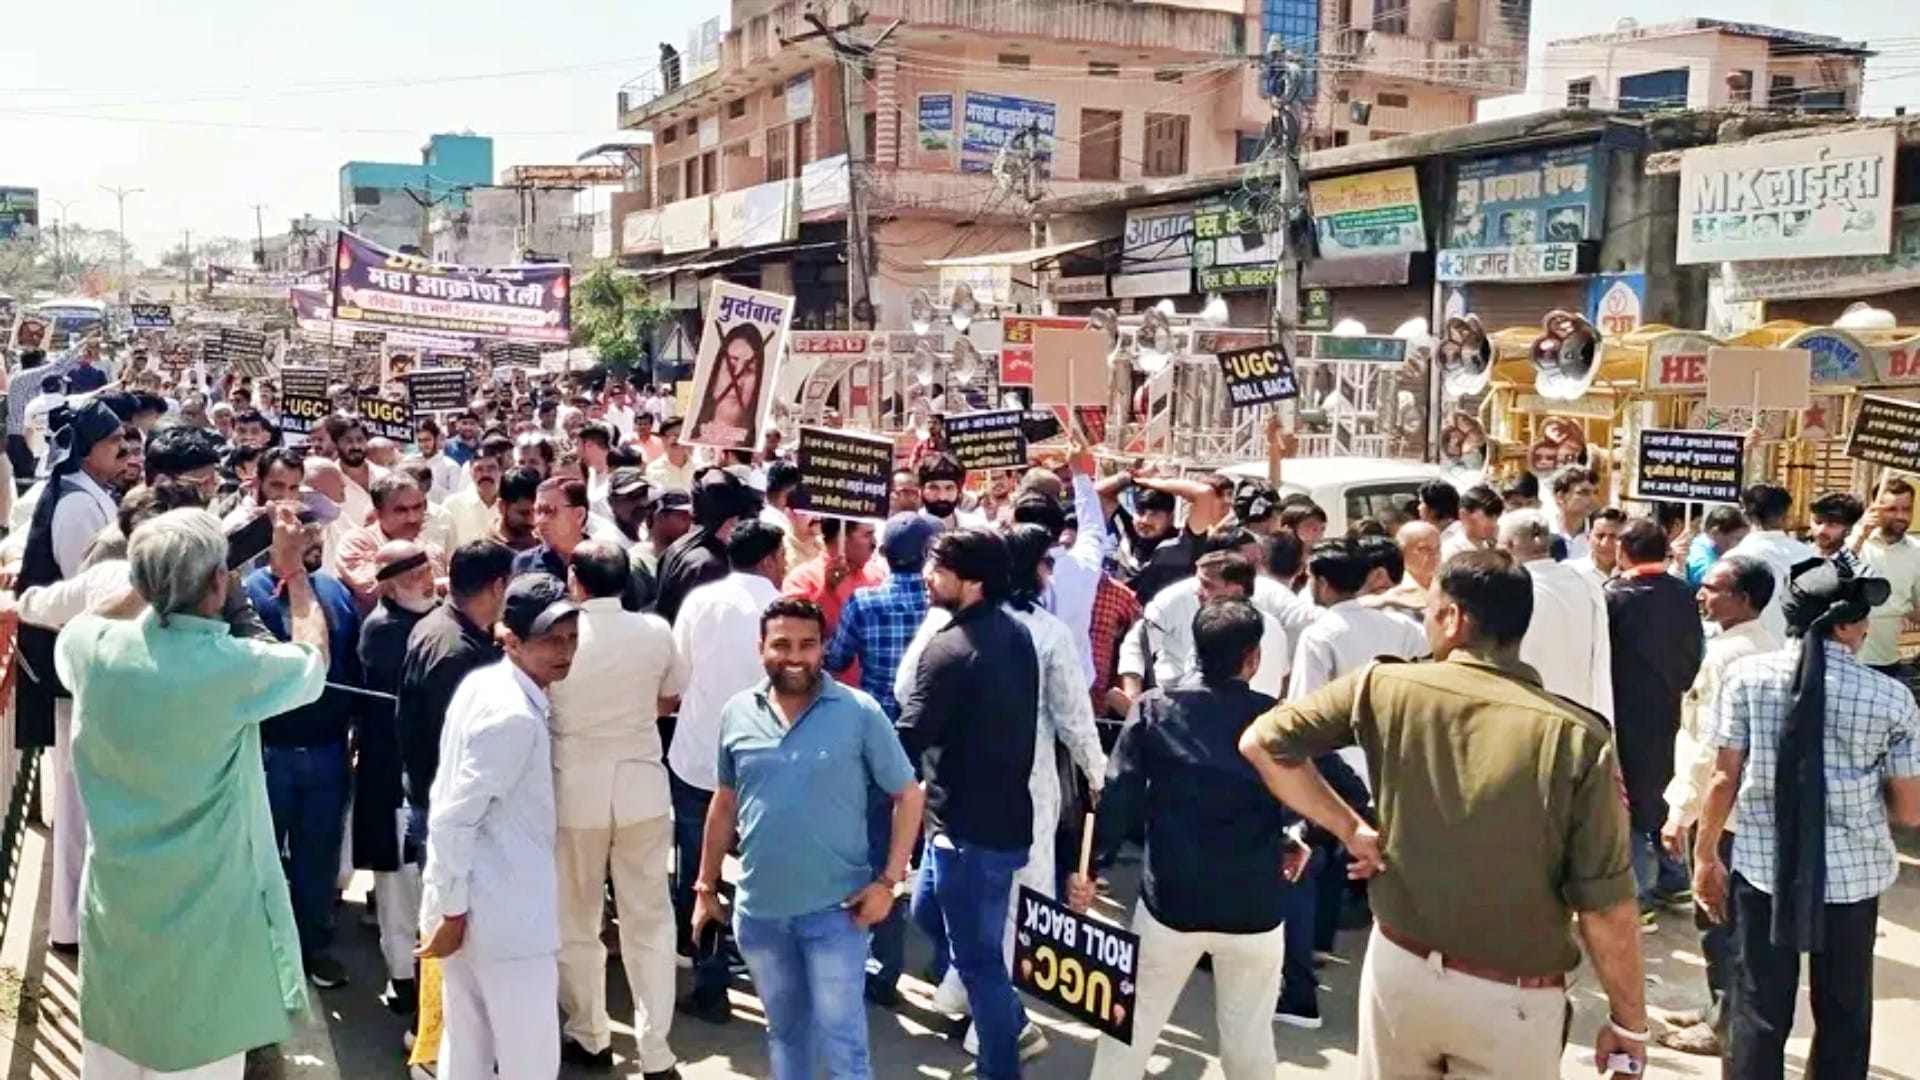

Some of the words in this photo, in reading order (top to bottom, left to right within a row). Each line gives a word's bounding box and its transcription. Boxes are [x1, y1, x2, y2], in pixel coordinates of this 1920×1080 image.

[368, 266, 411, 292] महा
[719, 295, 784, 325] मुर्दाबाद
[1232, 350, 1279, 380] UGC
[1231, 380, 1264, 402] ROLL
[1263, 376, 1296, 396] BACK
[289, 398, 324, 418] UGC
[367, 401, 405, 424] UGC
[1024, 897, 1076, 948] BACK
[1082, 922, 1133, 974] ROLL
[1033, 944, 1112, 1022] UGC
